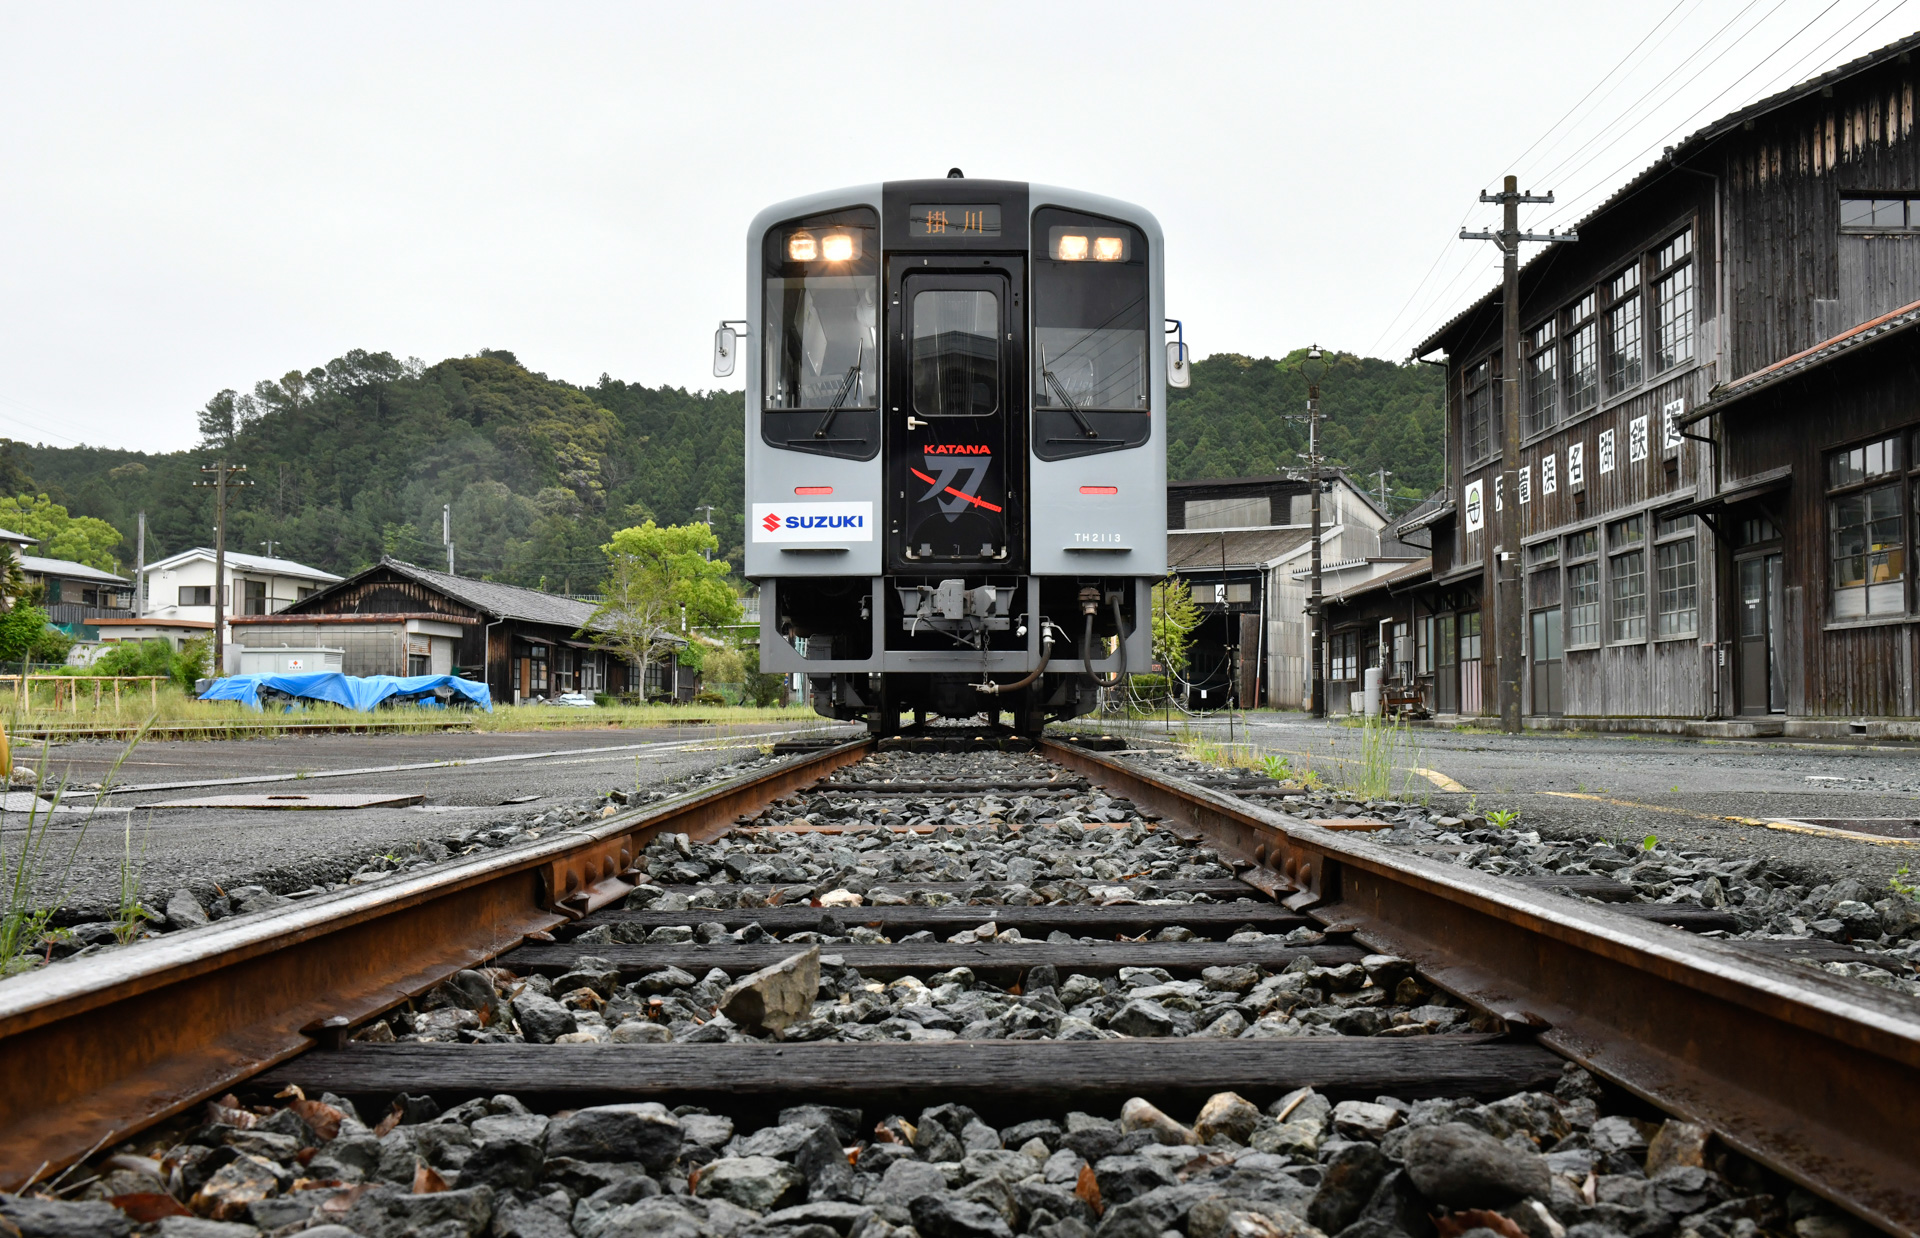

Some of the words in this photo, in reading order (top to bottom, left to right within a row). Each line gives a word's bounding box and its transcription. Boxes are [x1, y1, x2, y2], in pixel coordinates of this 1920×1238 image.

[926, 210, 982, 234] 掛川
[924, 444, 992, 455] KATANA
[785, 515, 864, 528] SUZUKI
[1074, 533, 1121, 543] TH2113
